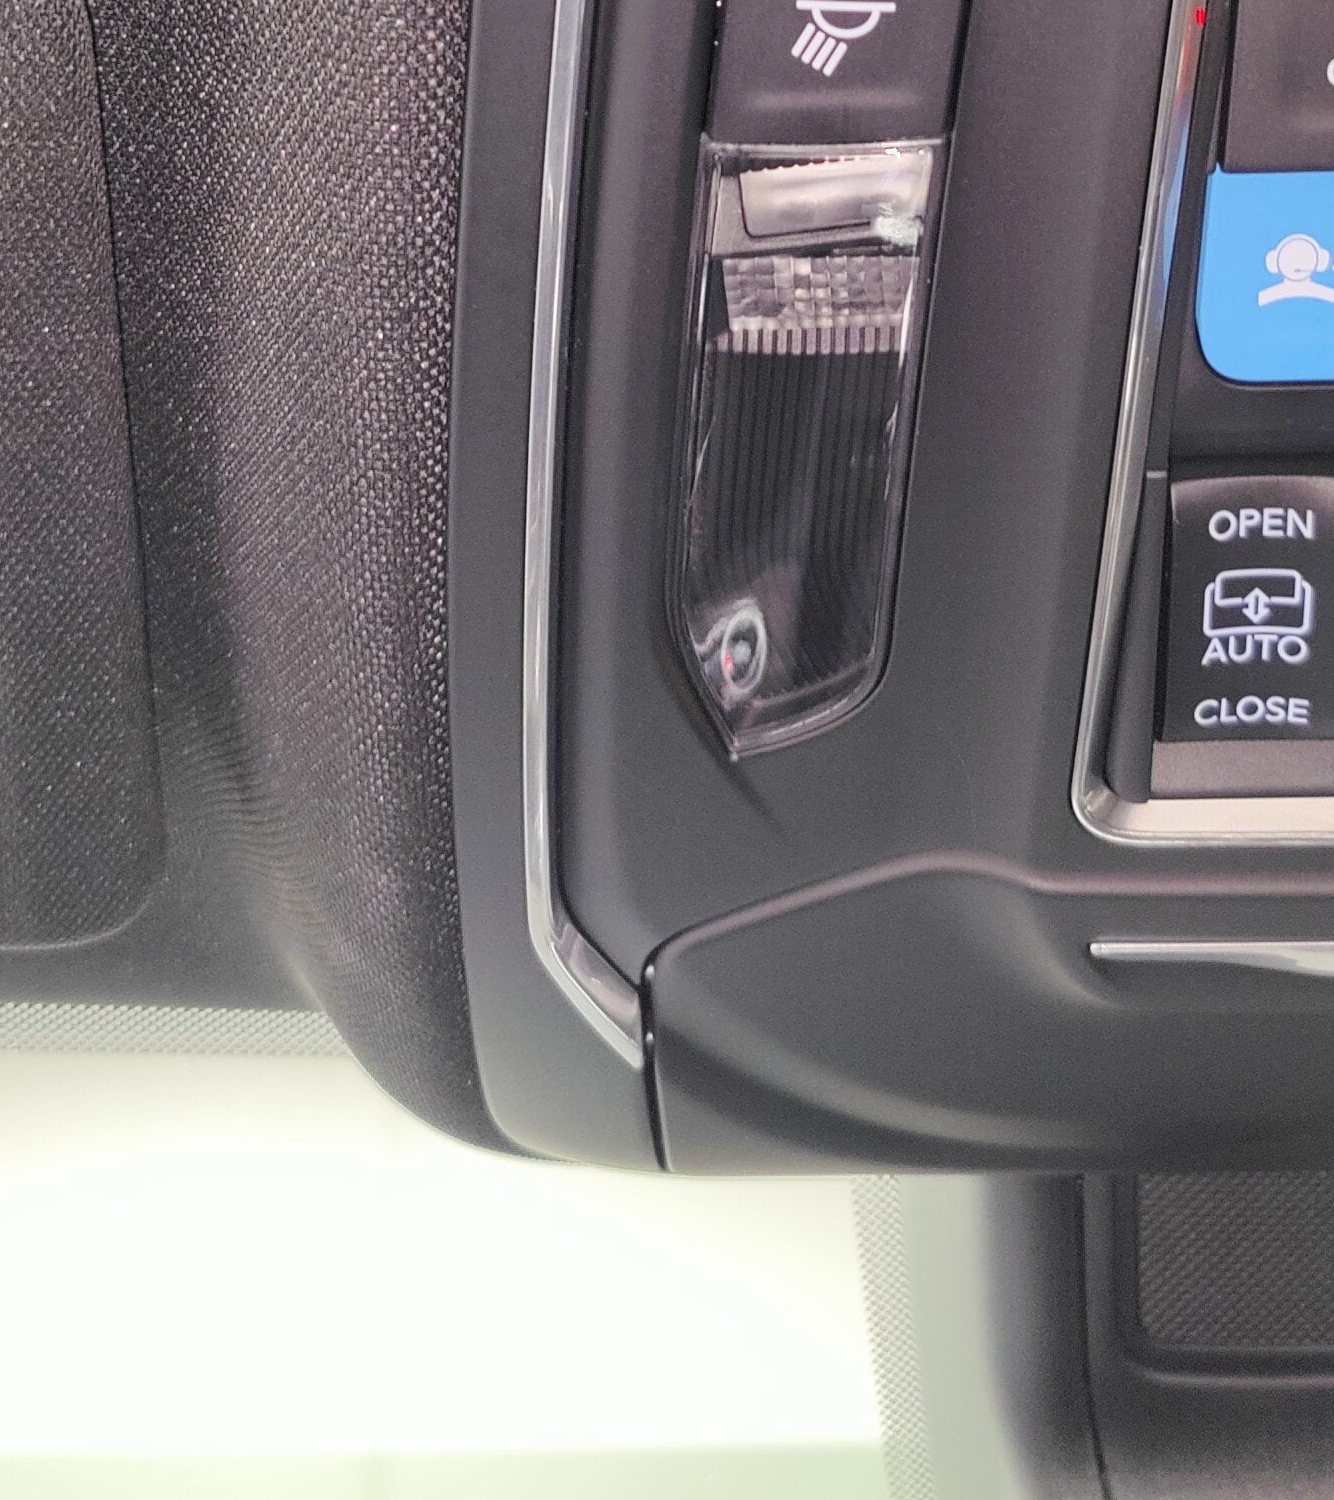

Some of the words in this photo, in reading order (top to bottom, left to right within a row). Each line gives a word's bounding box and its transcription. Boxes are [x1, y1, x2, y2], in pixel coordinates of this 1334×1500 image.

[1208, 509, 1315, 541] OPEN
[1202, 635, 1309, 666] AUTO
[1194, 696, 1310, 724] CLOSE
